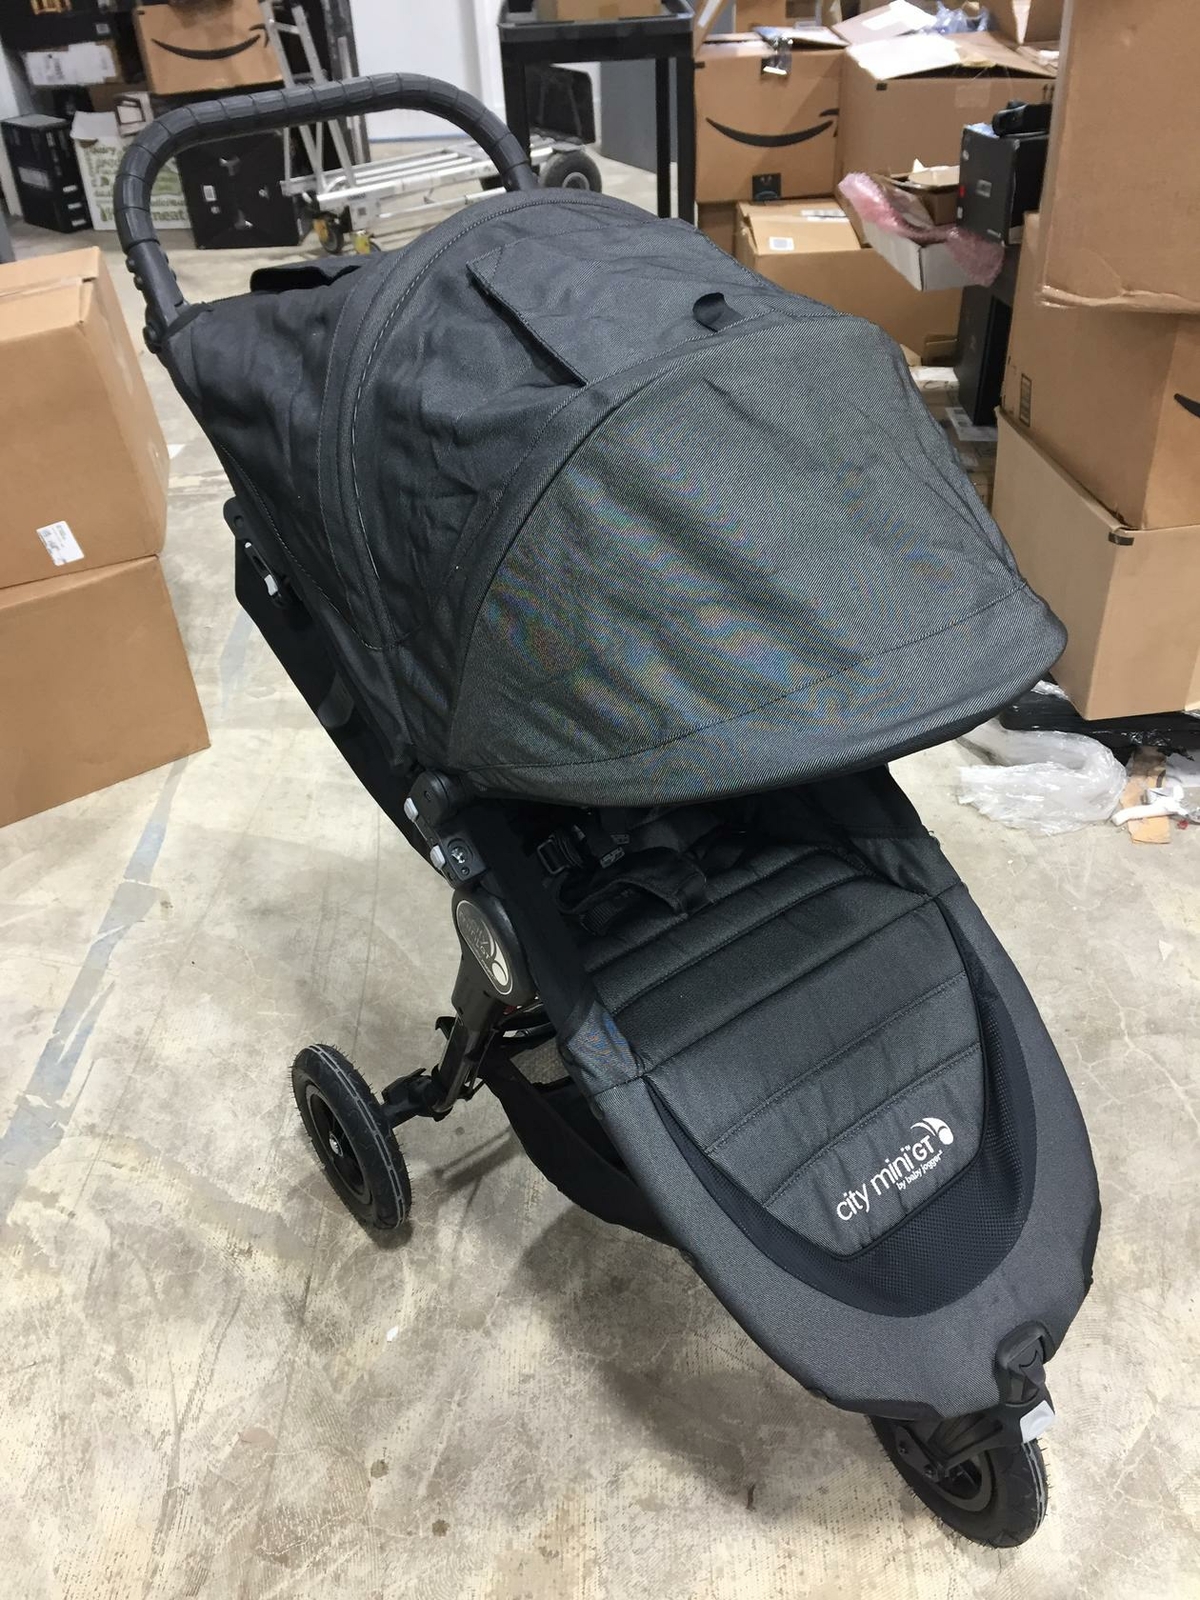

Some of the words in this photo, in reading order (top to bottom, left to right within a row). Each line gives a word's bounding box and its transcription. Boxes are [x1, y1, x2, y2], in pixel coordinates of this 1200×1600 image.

[836, 1183, 870, 1221] city
[911, 1135, 935, 1161] GT
[895, 1179, 907, 1191] by
[905, 1167, 922, 1183] baby
